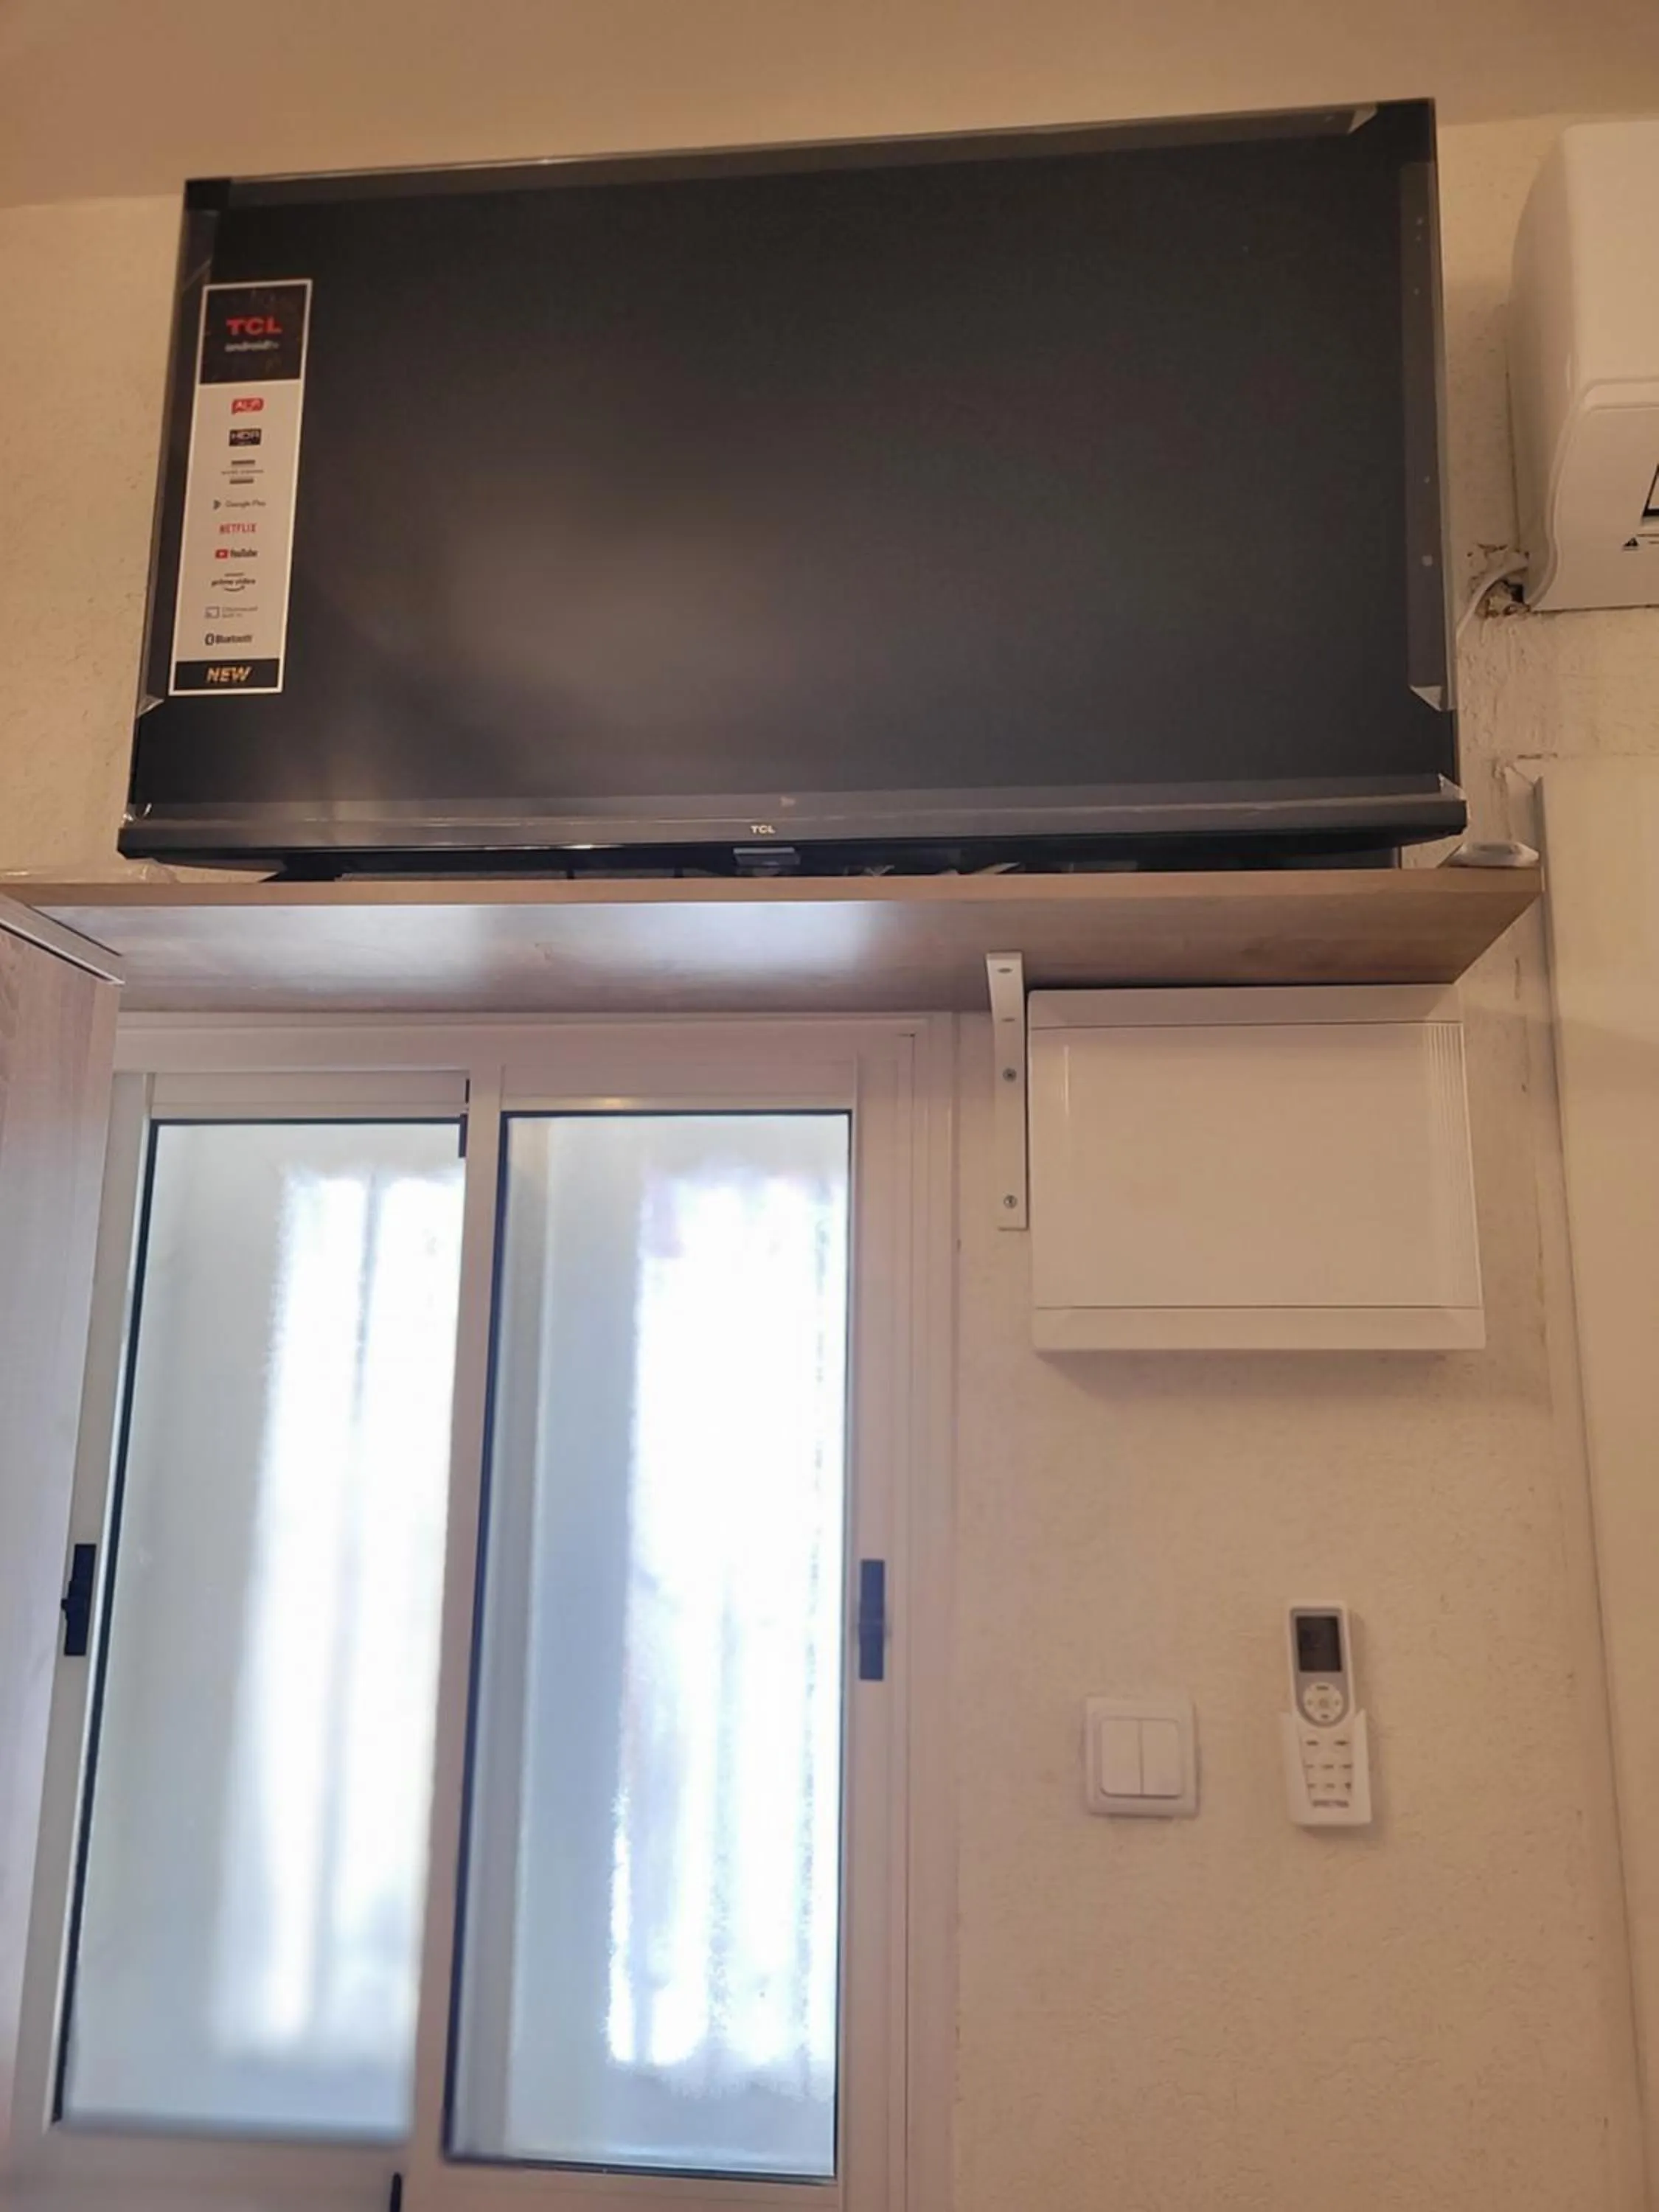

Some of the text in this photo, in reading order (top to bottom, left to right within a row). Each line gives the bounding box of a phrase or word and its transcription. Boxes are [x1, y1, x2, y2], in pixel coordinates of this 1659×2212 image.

[226, 316, 282, 335] TCL
[220, 523, 257, 535] NETFLIX
[230, 548, 257, 557] YouTube
[206, 666, 251, 682] NEW
[751, 825, 776, 834] TCL
